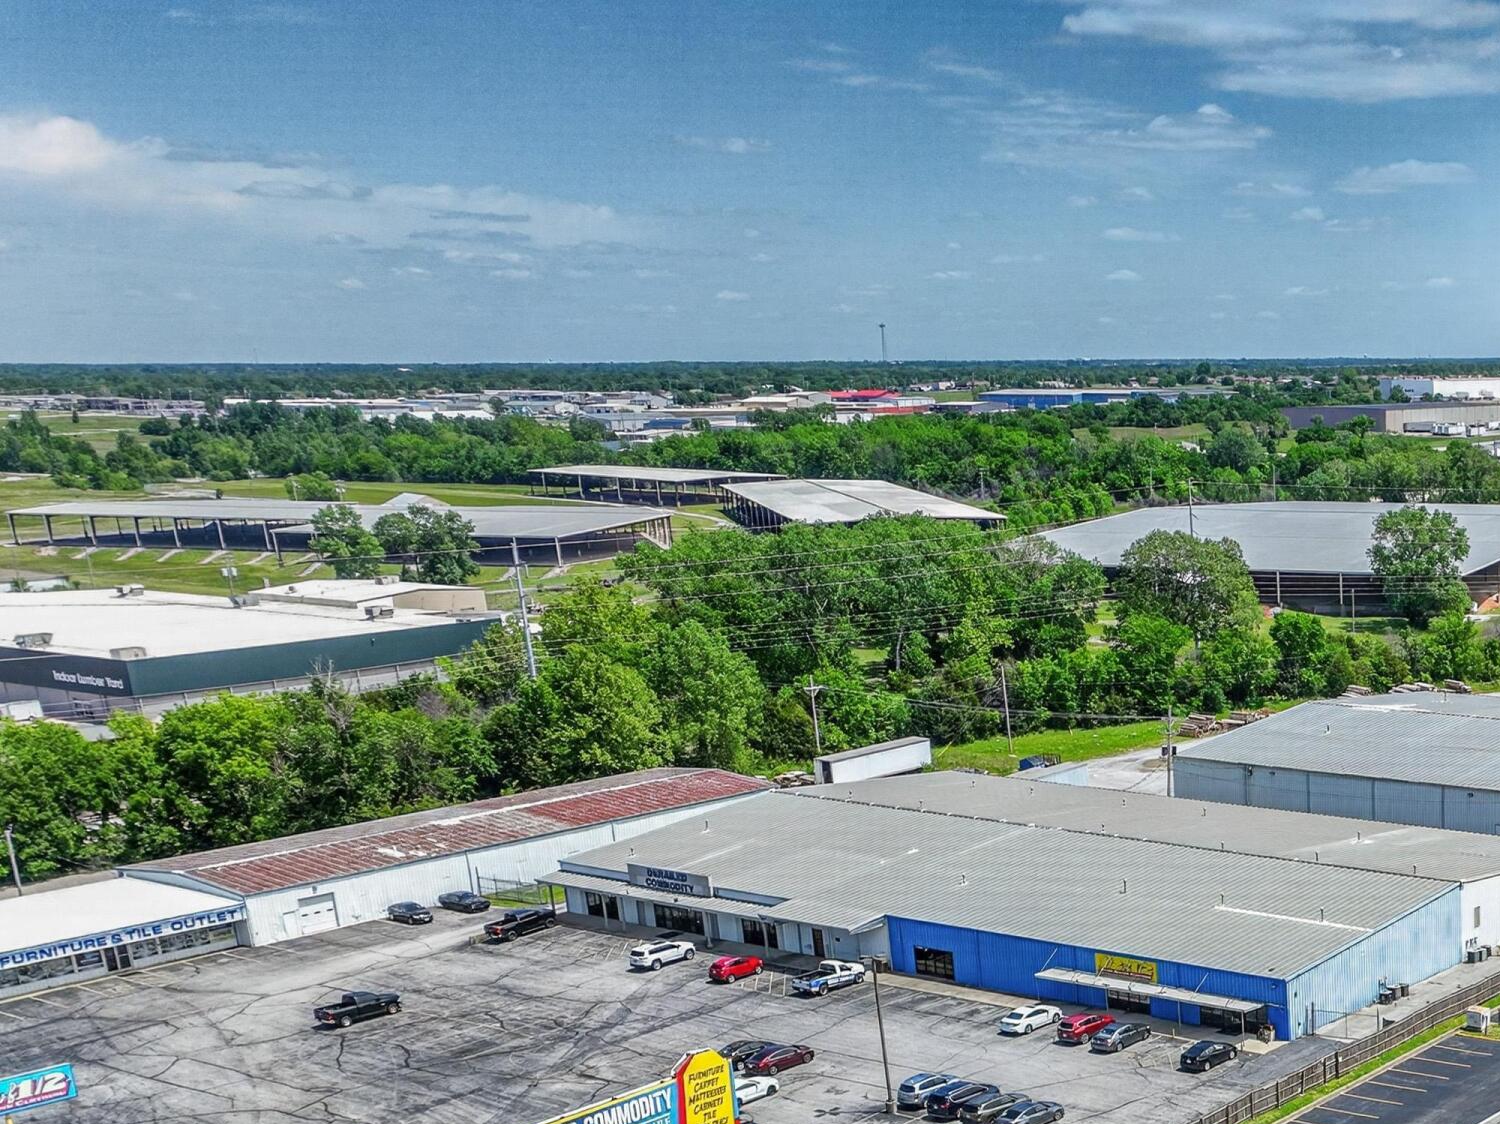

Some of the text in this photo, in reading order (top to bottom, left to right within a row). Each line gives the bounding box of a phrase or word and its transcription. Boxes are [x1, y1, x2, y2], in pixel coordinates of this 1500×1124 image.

[646, 867, 688, 883] DERAILED
[646, 878, 694, 893] COMMODITY
[0, 909, 237, 968] FURNITURE & TILE OUTLET
[688, 1064, 725, 1084] FURNITURE
[694, 1077, 719, 1093] CARPET
[703, 1109, 717, 1123] TILE
